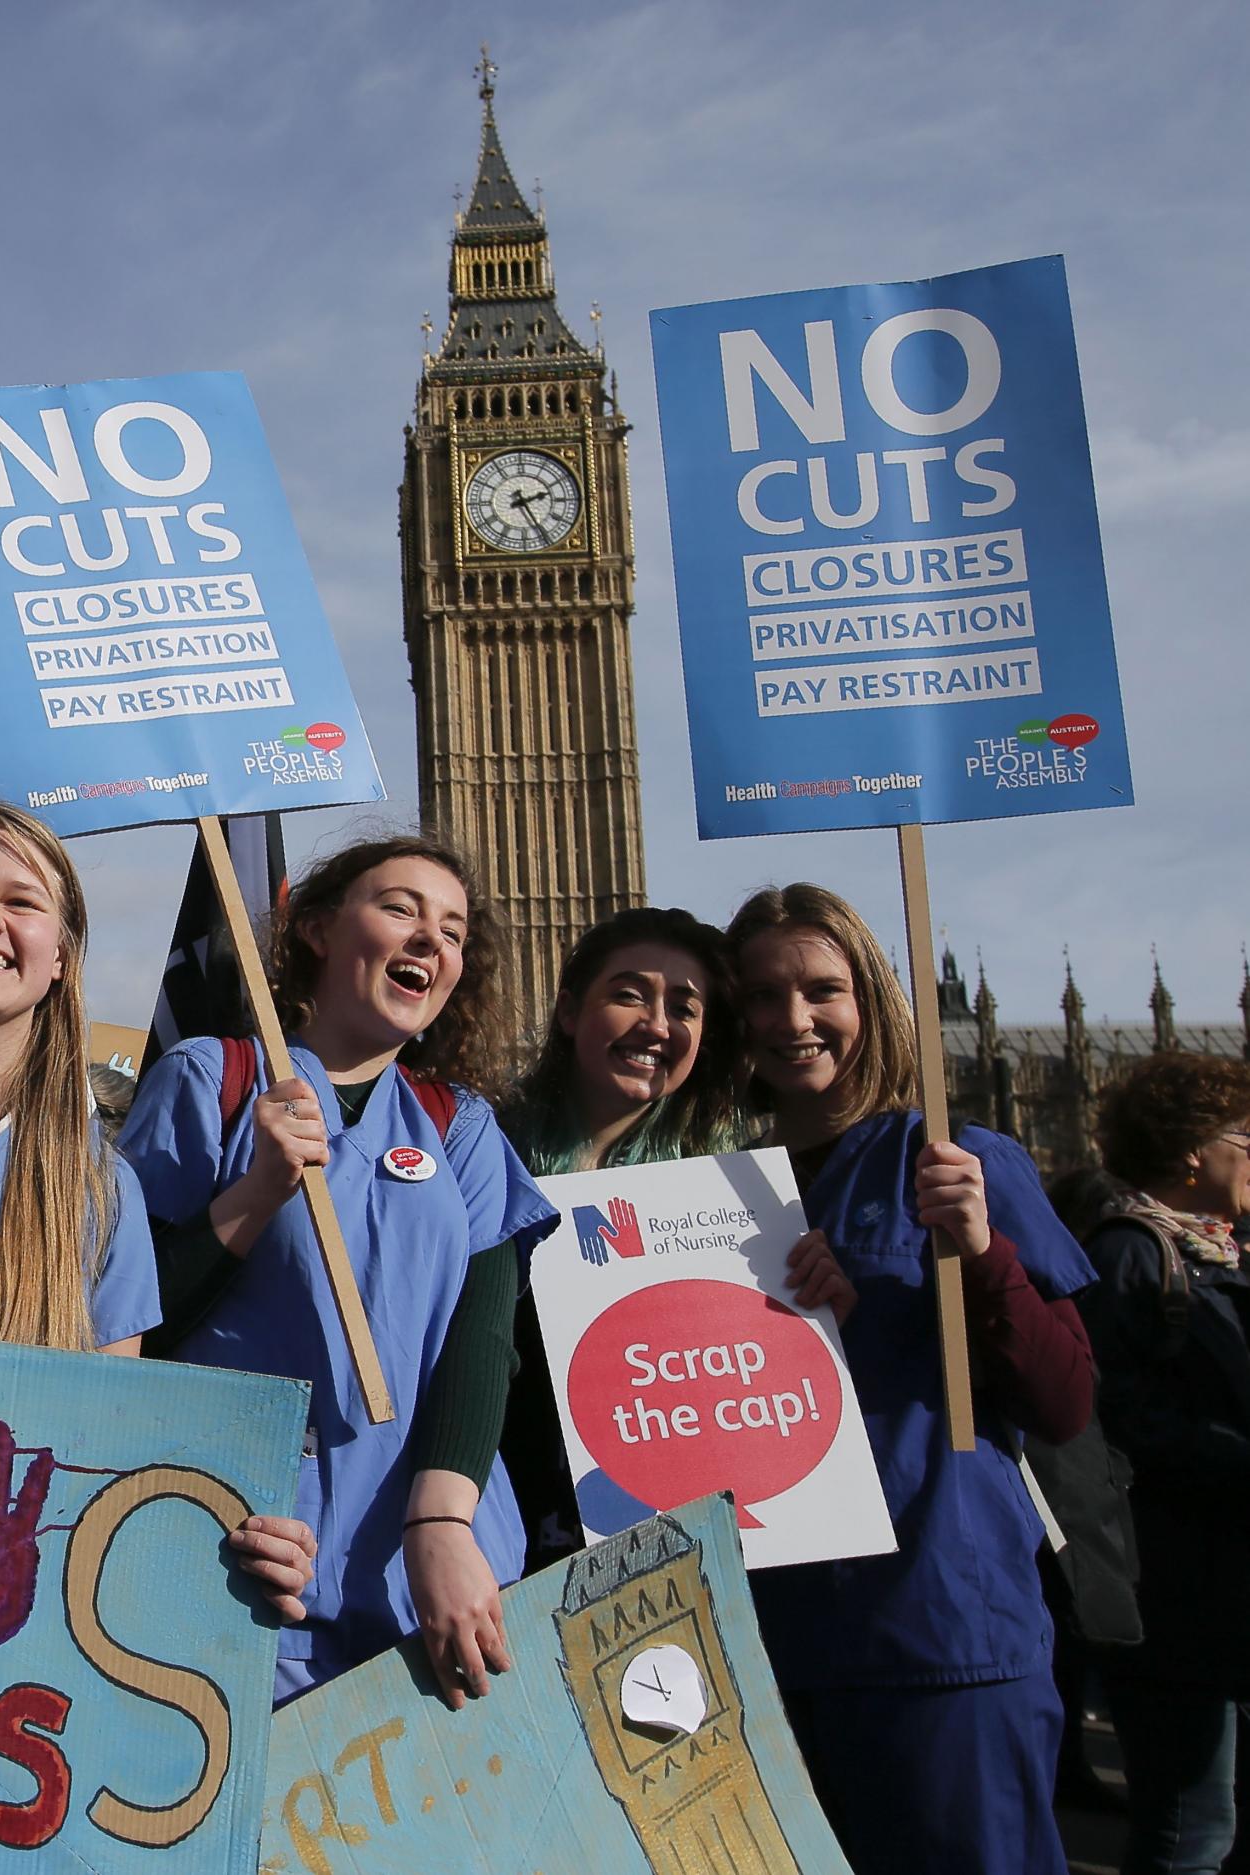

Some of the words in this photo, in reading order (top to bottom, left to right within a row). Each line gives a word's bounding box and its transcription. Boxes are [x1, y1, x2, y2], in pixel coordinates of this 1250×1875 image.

[719, 308, 1002, 453] NO
[736, 438, 1017, 535] CUTS
[0, 502, 242, 576] CUTS
[752, 539, 1013, 597] CLOSURES
[24, 580, 251, 628] CLOSURES
[755, 601, 1027, 651] PRIVATISATION
[34, 630, 272, 671] PRIVATISATION
[48, 694, 108, 720] PAY
[118, 678, 283, 713] RESTRAINT
[760, 678, 828, 709] PAY
[839, 659, 1034, 701] RESTRAINT
[248, 740, 286, 756] THE
[308, 731, 343, 739] AUSTERITY
[974, 737, 1019, 756] THE
[1050, 724, 1096, 735] AUSTERITY
[27, 785, 78, 808] Health
[79, 779, 147, 799] Campaigns
[144, 772, 209, 793] Together
[273, 767, 343, 785] ASSEMBLY
[725, 782, 777, 802] Health
[779, 779, 852, 799] Campaigns
[852, 773, 922, 794] Together
[996, 766, 1087, 790] ASSEMBLY
[648, 1212, 694, 1236] Royal
[696, 1208, 756, 1228] College
[653, 1237, 670, 1255] of
[674, 1232, 740, 1252] Nursing
[624, 1340, 766, 1387] Scrap
[612, 1397, 701, 1444] the
[714, 1378, 820, 1437] cap!
